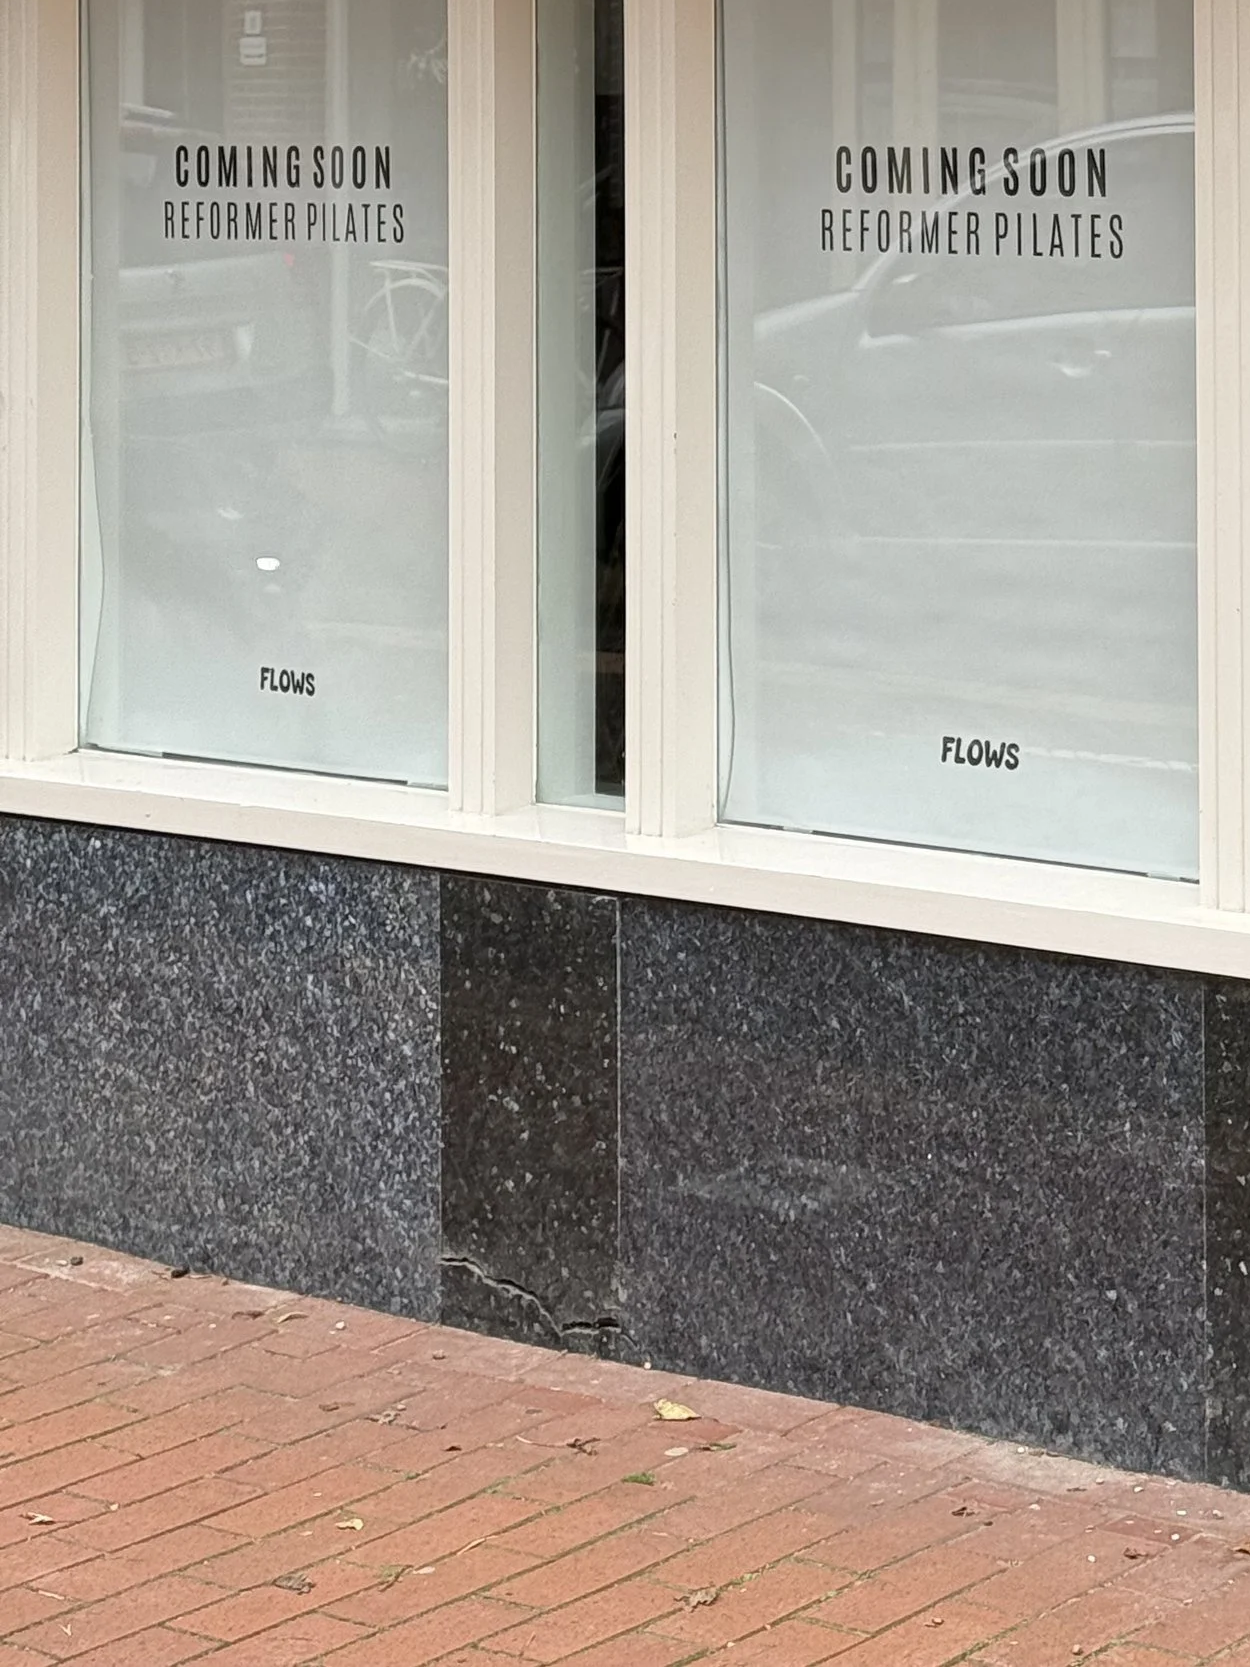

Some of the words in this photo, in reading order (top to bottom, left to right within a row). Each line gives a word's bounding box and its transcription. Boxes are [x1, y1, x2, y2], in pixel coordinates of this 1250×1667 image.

[175, 144, 300, 188] COMING
[313, 145, 391, 190] SOON
[836, 146, 986, 196] COMING
[1003, 147, 1106, 198] SOON
[164, 201, 296, 241] REFORMER
[307, 202, 404, 244] PILATES
[821, 208, 980, 256] REFORMER
[995, 212, 1124, 259] PILATES
[260, 666, 316, 697] FLOWS
[941, 736, 1021, 771] FLOWS
